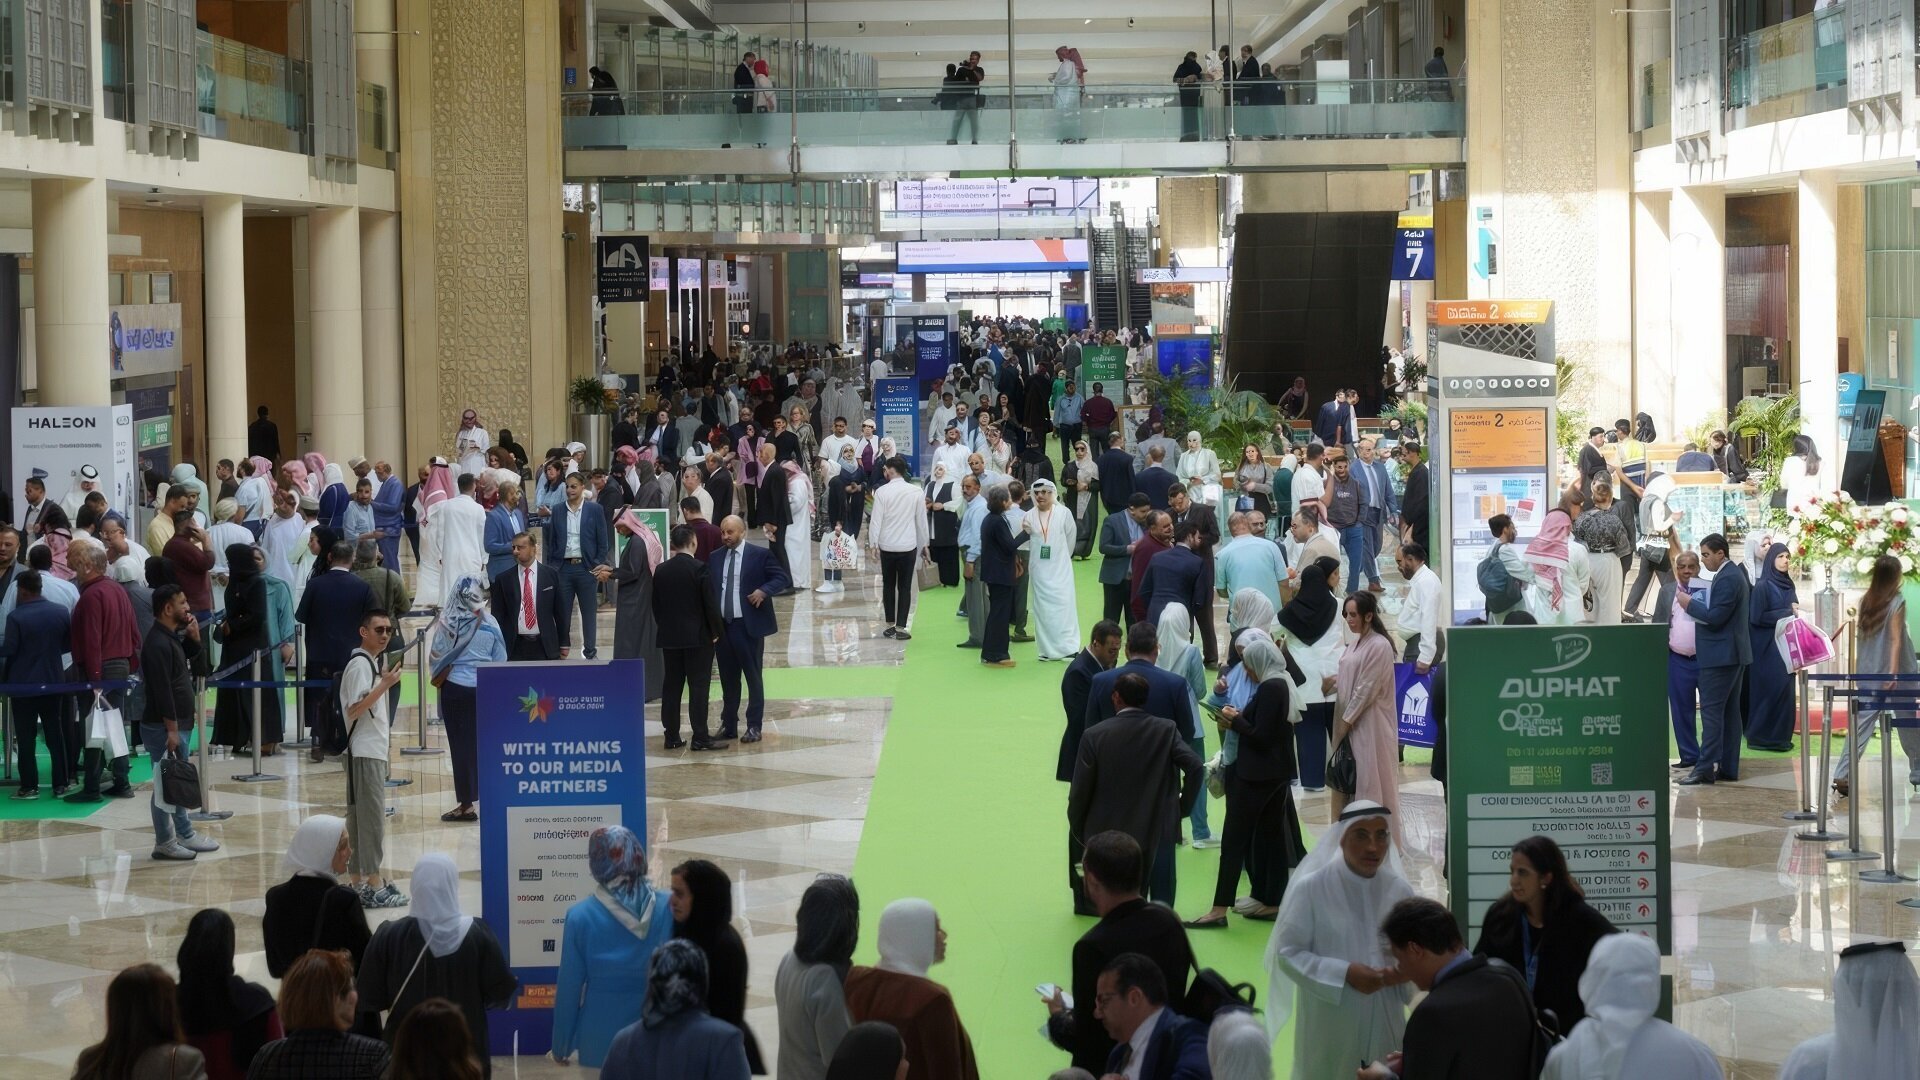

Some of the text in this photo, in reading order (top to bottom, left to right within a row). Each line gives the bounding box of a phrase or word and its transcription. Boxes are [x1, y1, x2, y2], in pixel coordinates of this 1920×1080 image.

[1406, 247, 1424, 278] 7
[1489, 304, 1499, 320] 2
[28, 417, 97, 428] HALEON
[1494, 413, 1504, 427] 2
[1498, 676, 1621, 698] DUPHAT
[502, 740, 621, 756] WITH THANKS
[502, 759, 623, 776] TO OUR MEDIA
[518, 779, 608, 794] PARTNERS
